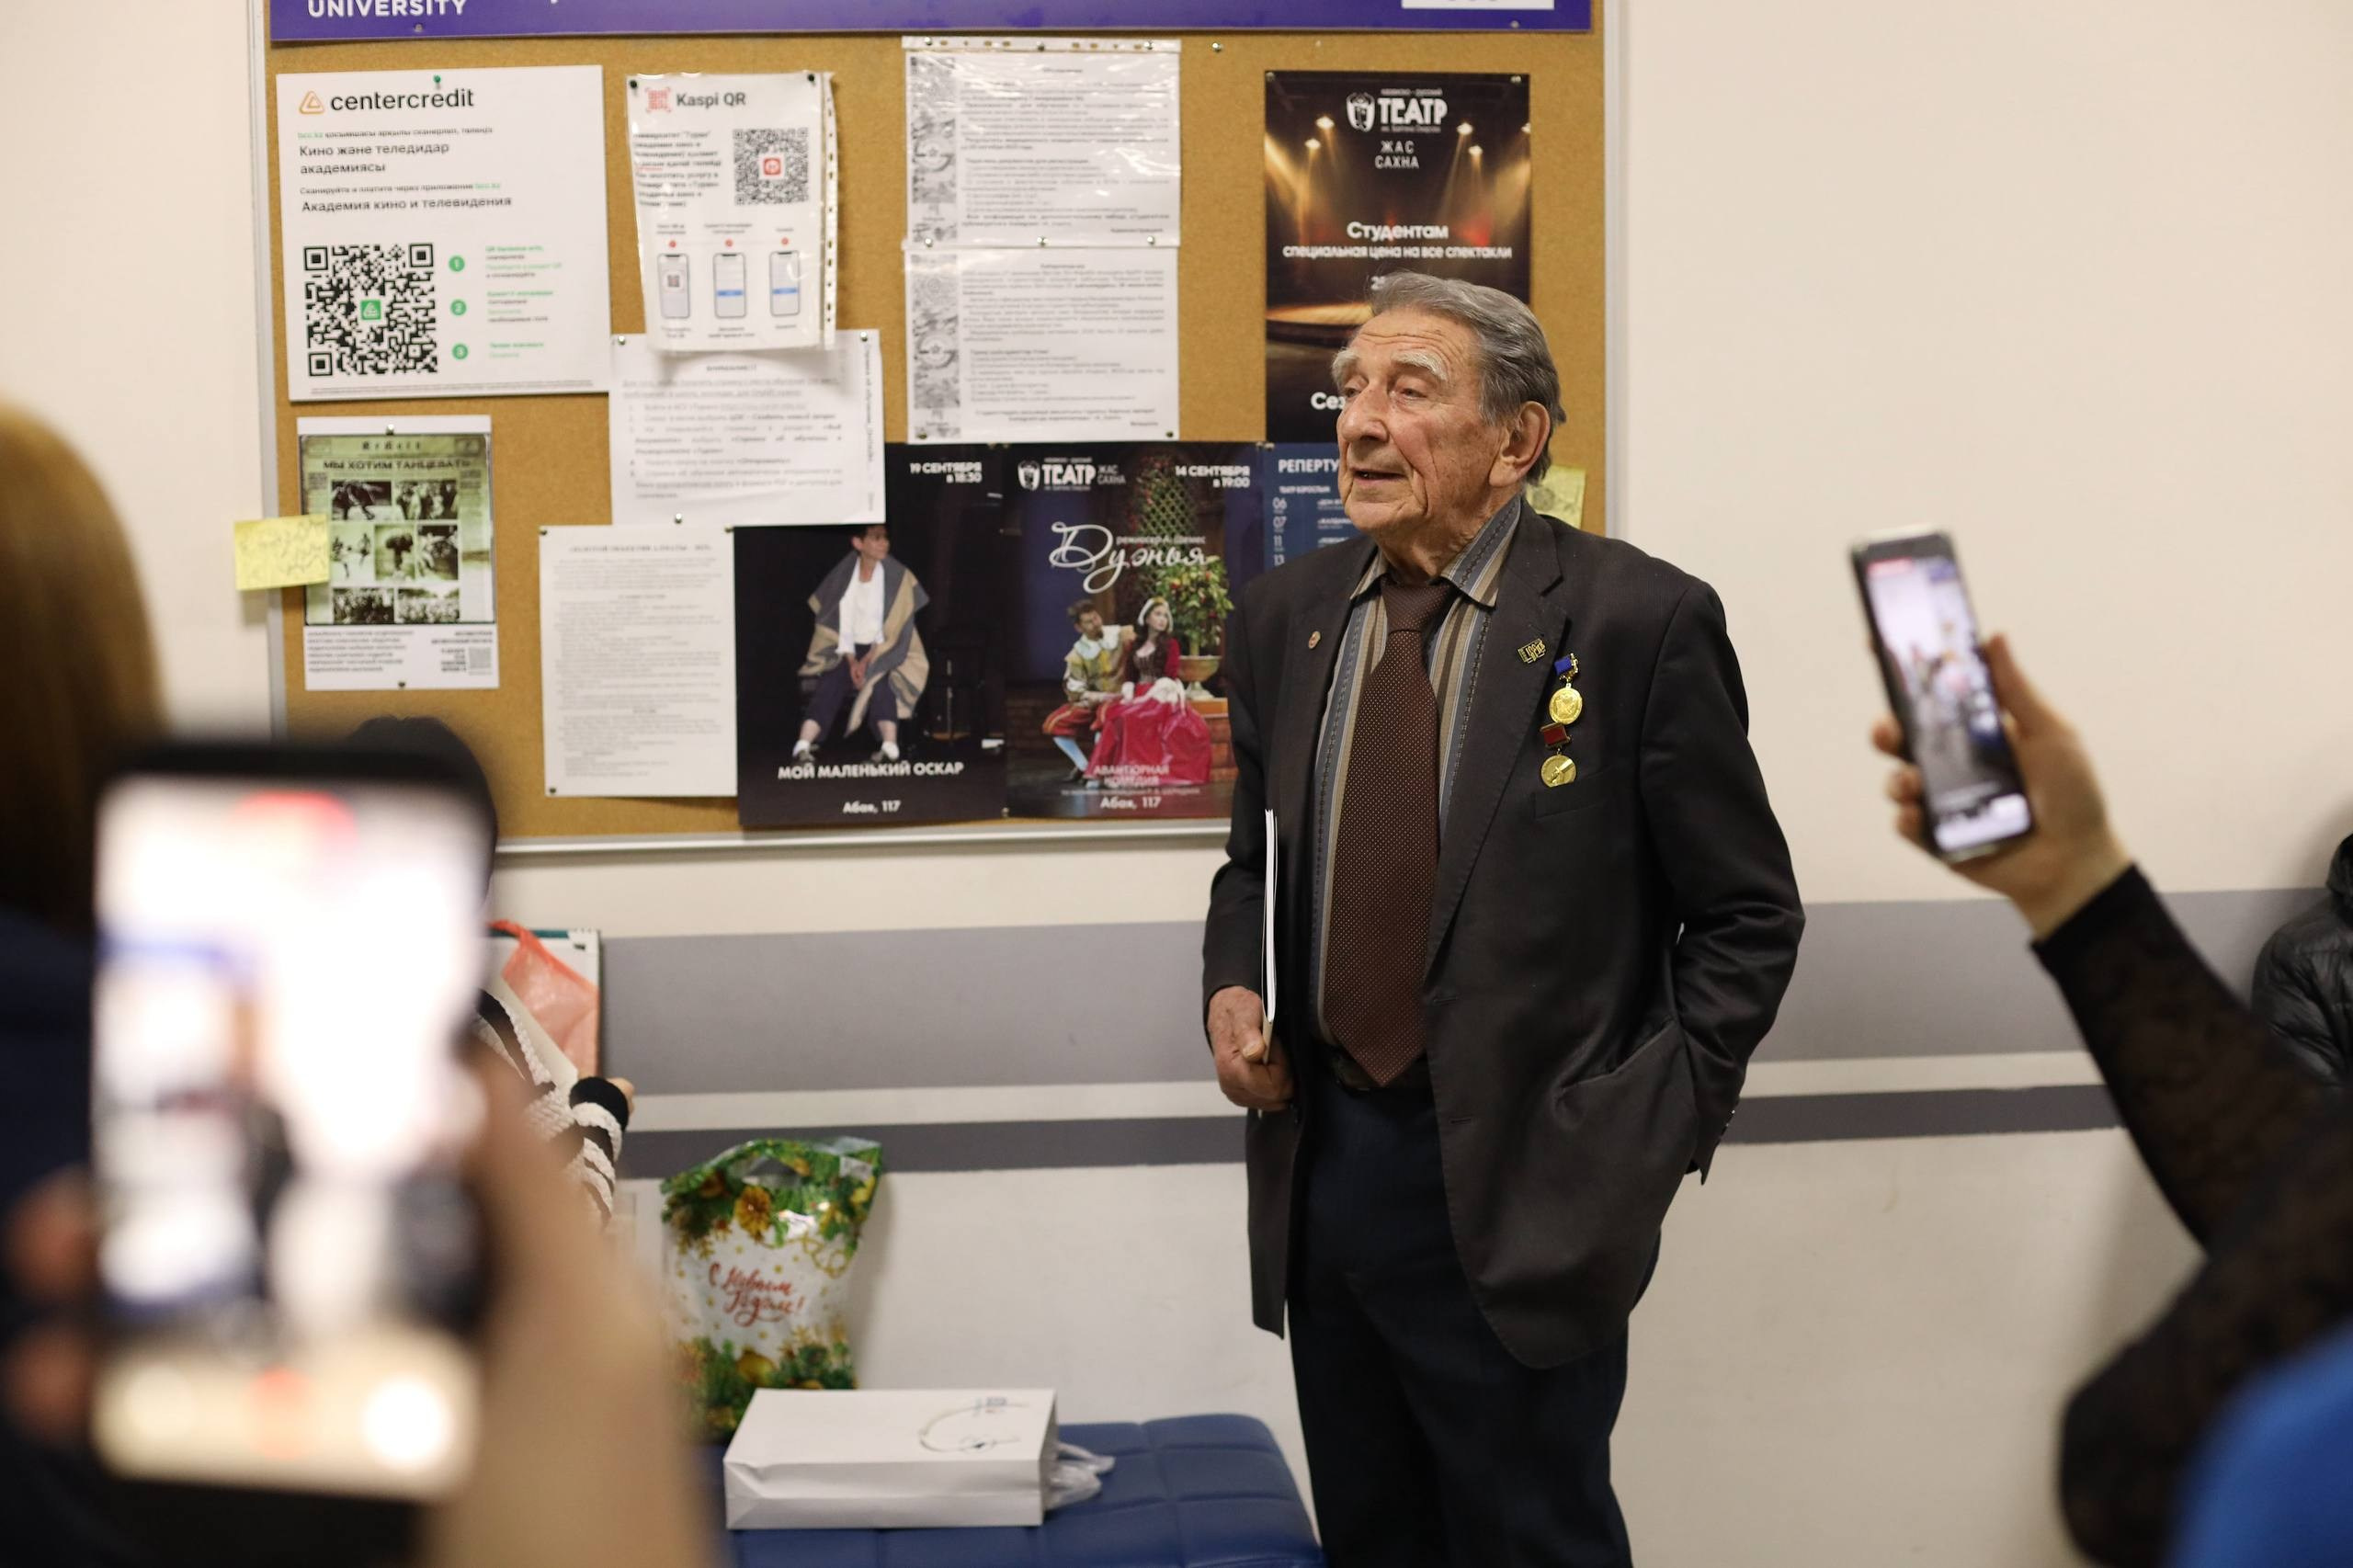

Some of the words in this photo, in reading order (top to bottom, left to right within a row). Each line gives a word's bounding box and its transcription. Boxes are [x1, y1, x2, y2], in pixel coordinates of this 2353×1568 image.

[308, 0, 466, 17] UNIVERSITY
[331, 88, 473, 111] centercredit
[676, 93, 719, 108] Kaspi
[723, 93, 746, 106] QR
[1377, 97, 1449, 124] ТЕАТР
[300, 144, 334, 156] Кино
[376, 142, 449, 155] теледидар
[1381, 140, 1415, 153] ЖАС
[301, 162, 386, 175] академиясы
[1374, 155, 1419, 169] САХНА
[301, 200, 369, 212] Академия
[374, 199, 406, 210] кино
[410, 200, 418, 209] и
[422, 198, 512, 210] телевидения
[1347, 221, 1449, 242] Студентам
[1282, 245, 1368, 258] специальная
[1370, 245, 1402, 258] цена
[1403, 246, 1420, 257] на
[1422, 246, 1444, 257] все
[1445, 246, 1512, 258] спектакли
[1041, 464, 1097, 485] ТЕАТР
[778, 762, 815, 779] МОЙ
[818, 760, 911, 778] МАЛЕНЬКИЙ
[913, 761, 964, 776] ОСКАР
[881, 800, 902, 812] 117
[1142, 796, 1162, 808] 117
